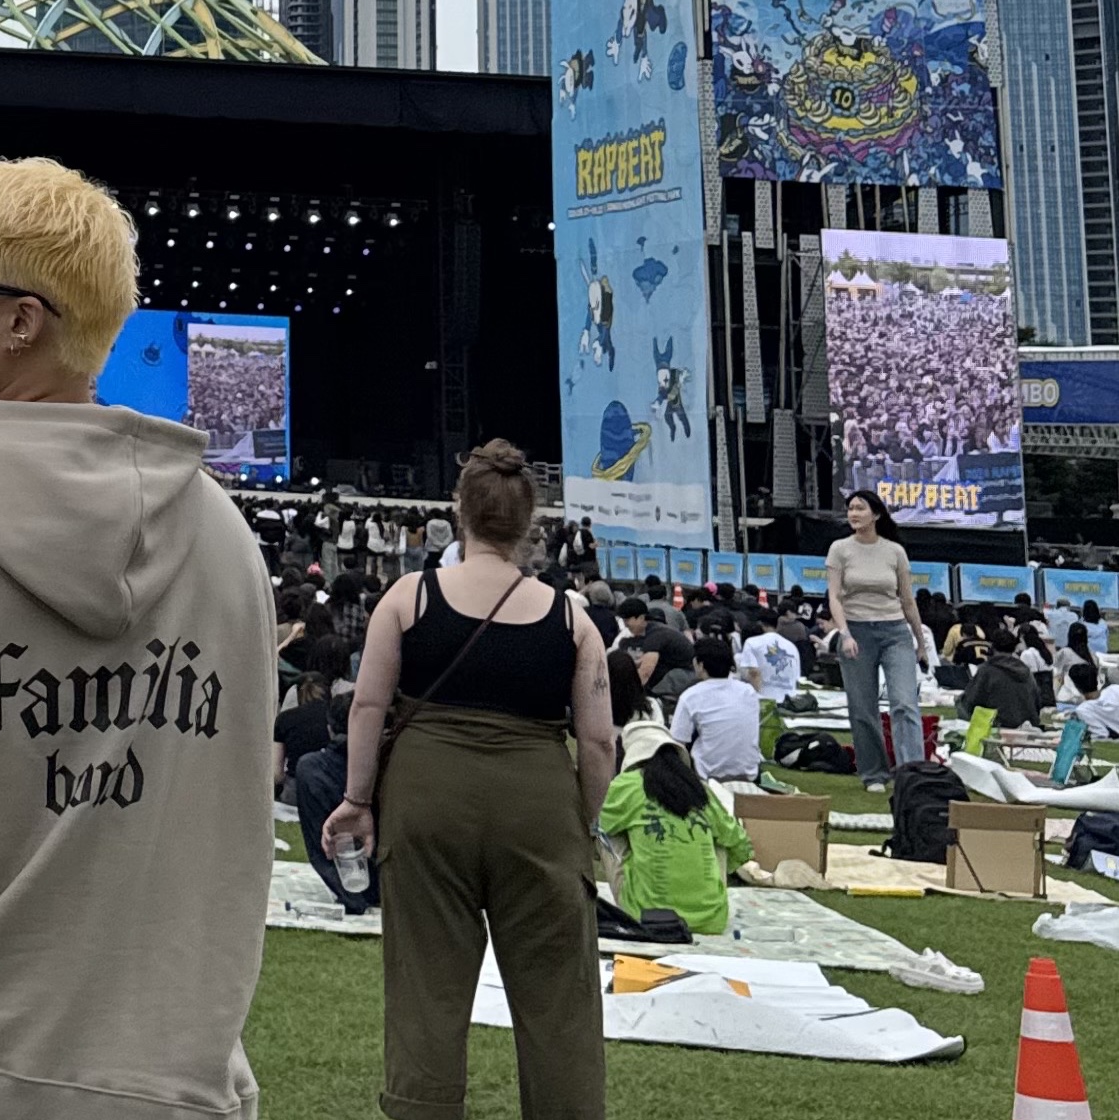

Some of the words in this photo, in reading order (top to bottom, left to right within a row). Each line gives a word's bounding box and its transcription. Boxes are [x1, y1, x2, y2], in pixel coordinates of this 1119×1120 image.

[834, 89, 852, 108] 10
[576, 129, 665, 198] RAPBEAT
[877, 482, 981, 511] RAPBEAT
